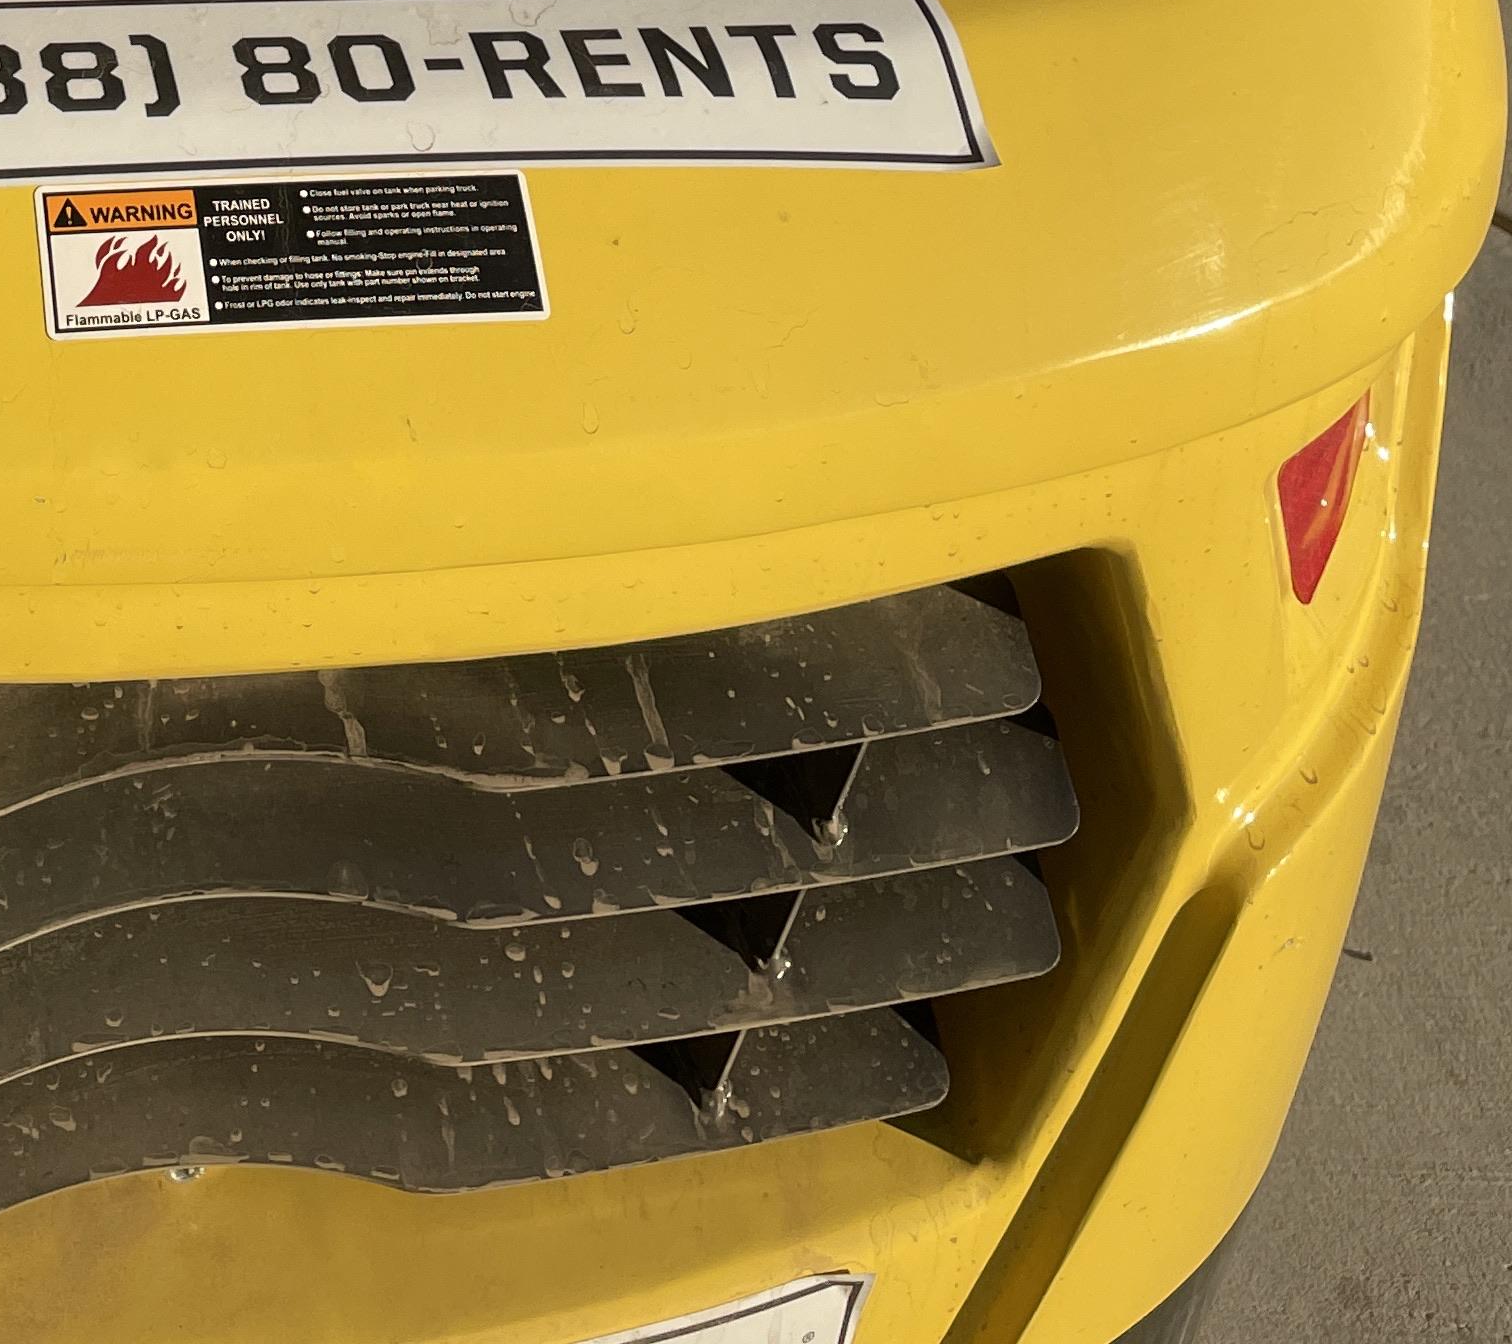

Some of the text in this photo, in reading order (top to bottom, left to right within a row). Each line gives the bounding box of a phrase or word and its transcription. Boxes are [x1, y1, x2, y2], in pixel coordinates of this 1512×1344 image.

[230, 23, 901, 108] 80-RENTS
[309, 189, 332, 197] Close
[334, 188, 349, 196] fuel
[426, 186, 455, 194] parking
[212, 198, 270, 212] TRAINED
[340, 204, 360, 212] store
[391, 203, 408, 211] park
[410, 201, 430, 209] truck
[451, 200, 468, 208] heat
[480, 200, 509, 208] ignition
[90, 202, 194, 224] WARNING
[349, 212, 371, 220] Avoid
[373, 212, 400, 220] sparks
[432, 209, 456, 217] flame.
[203, 214, 285, 228] PERSONNEL
[225, 230, 266, 243] ONLY!
[316, 229, 342, 237] Follow
[344, 228, 366, 238] filling
[384, 227, 422, 236] operating
[423, 225, 469, 234] instructions
[480, 224, 518, 232] operating
[219, 258, 242, 266] When
[243, 257, 278, 266] checking
[289, 255, 311, 264] filling
[447, 249, 488, 258] designated
[232, 275, 262, 284] prevent
[263, 273, 294, 282] damage
[364, 269, 385, 277] Make
[405, 269, 417, 277] pin
[418, 267, 448, 275] extends
[449, 266, 480, 275] through
[222, 284, 239, 292] hole
[250, 283, 263, 291] rim
[310, 281, 328, 289] only
[328, 279, 346, 287] tank
[364, 278, 381, 287] part
[381, 277, 410, 285] number
[412, 276, 437, 284] shown
[449, 274, 481, 283] bracket.
[256, 299, 274, 308] LPG
[274, 299, 293, 307] odor
[294, 297, 329, 306] indicates
[378, 294, 393, 303] and
[393, 294, 416, 304] repair
[491, 290, 509, 298] start
[66, 307, 201, 327] Flammable LP-GAS
